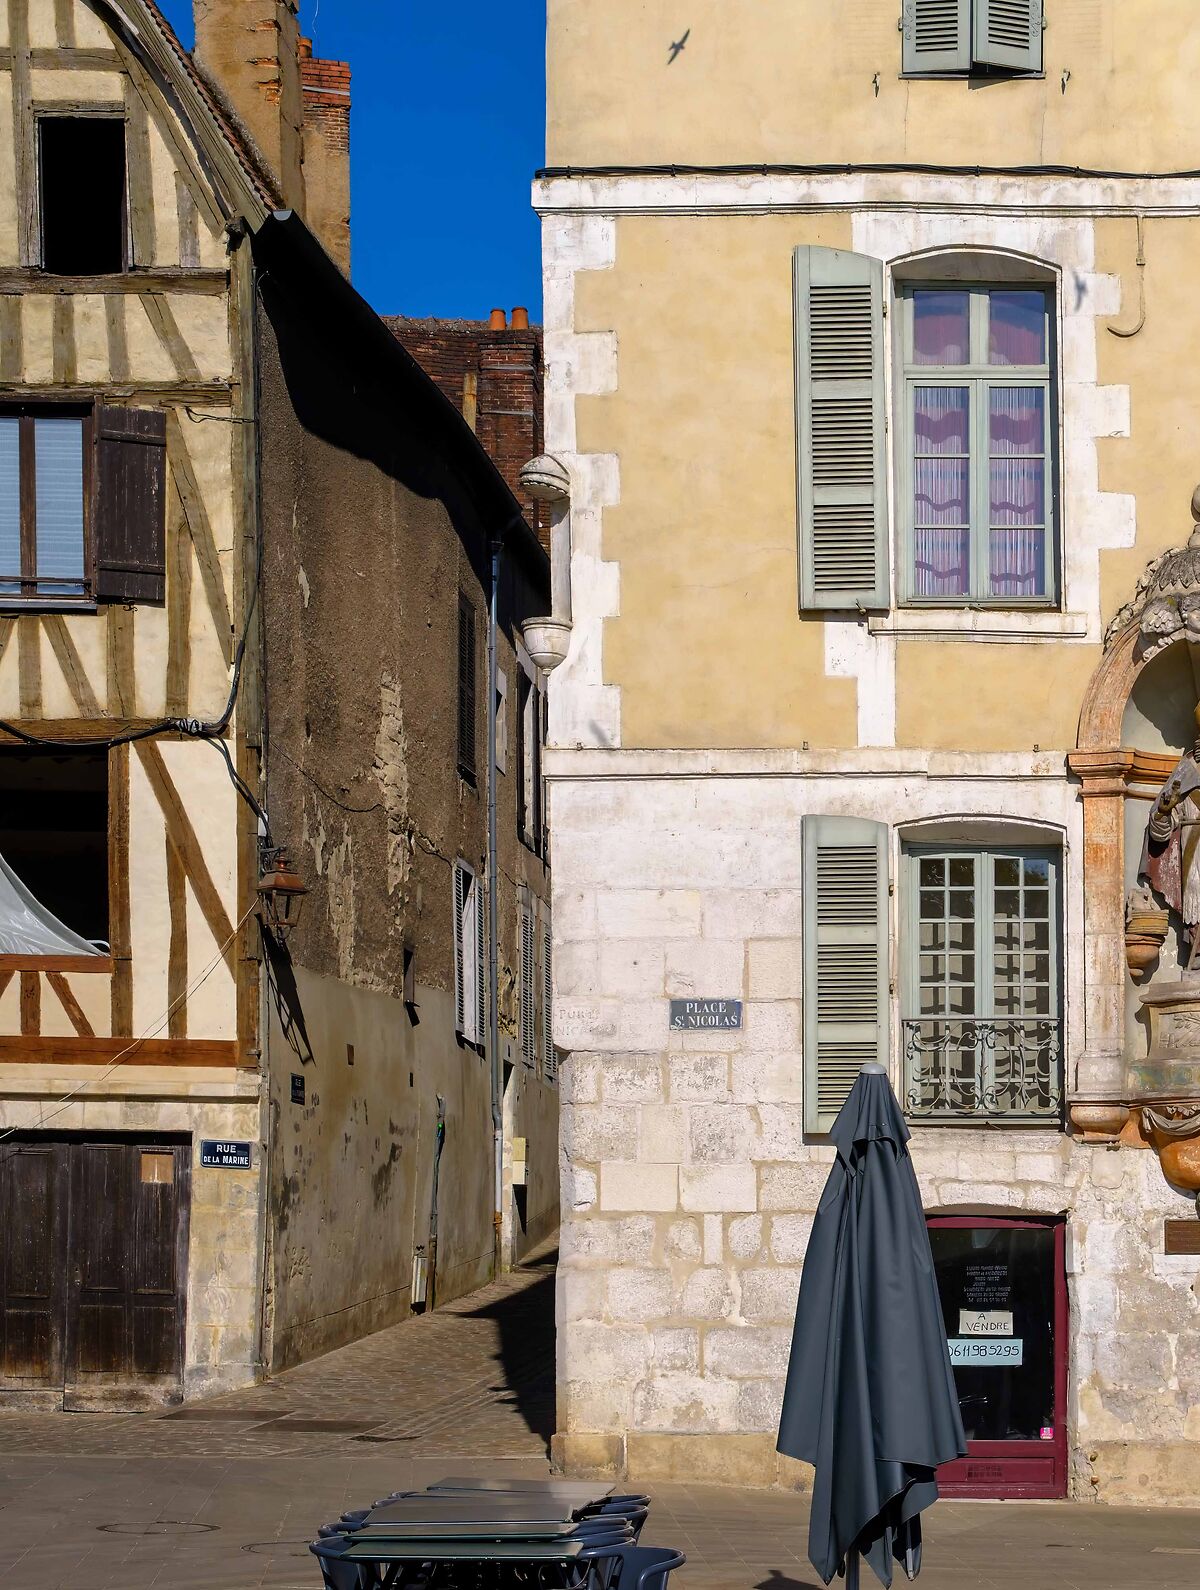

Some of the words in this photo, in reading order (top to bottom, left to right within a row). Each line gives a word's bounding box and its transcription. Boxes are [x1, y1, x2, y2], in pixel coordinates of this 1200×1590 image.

[686, 1002, 727, 1013] PLACE
[688, 1015, 738, 1026] NICOLAS
[216, 1144, 237, 1153] RUE
[203, 1155, 211, 1163] DE
[222, 1155, 249, 1165] MARINE
[977, 1313, 986, 1321] A
[966, 1322, 1010, 1332] VENDRE
